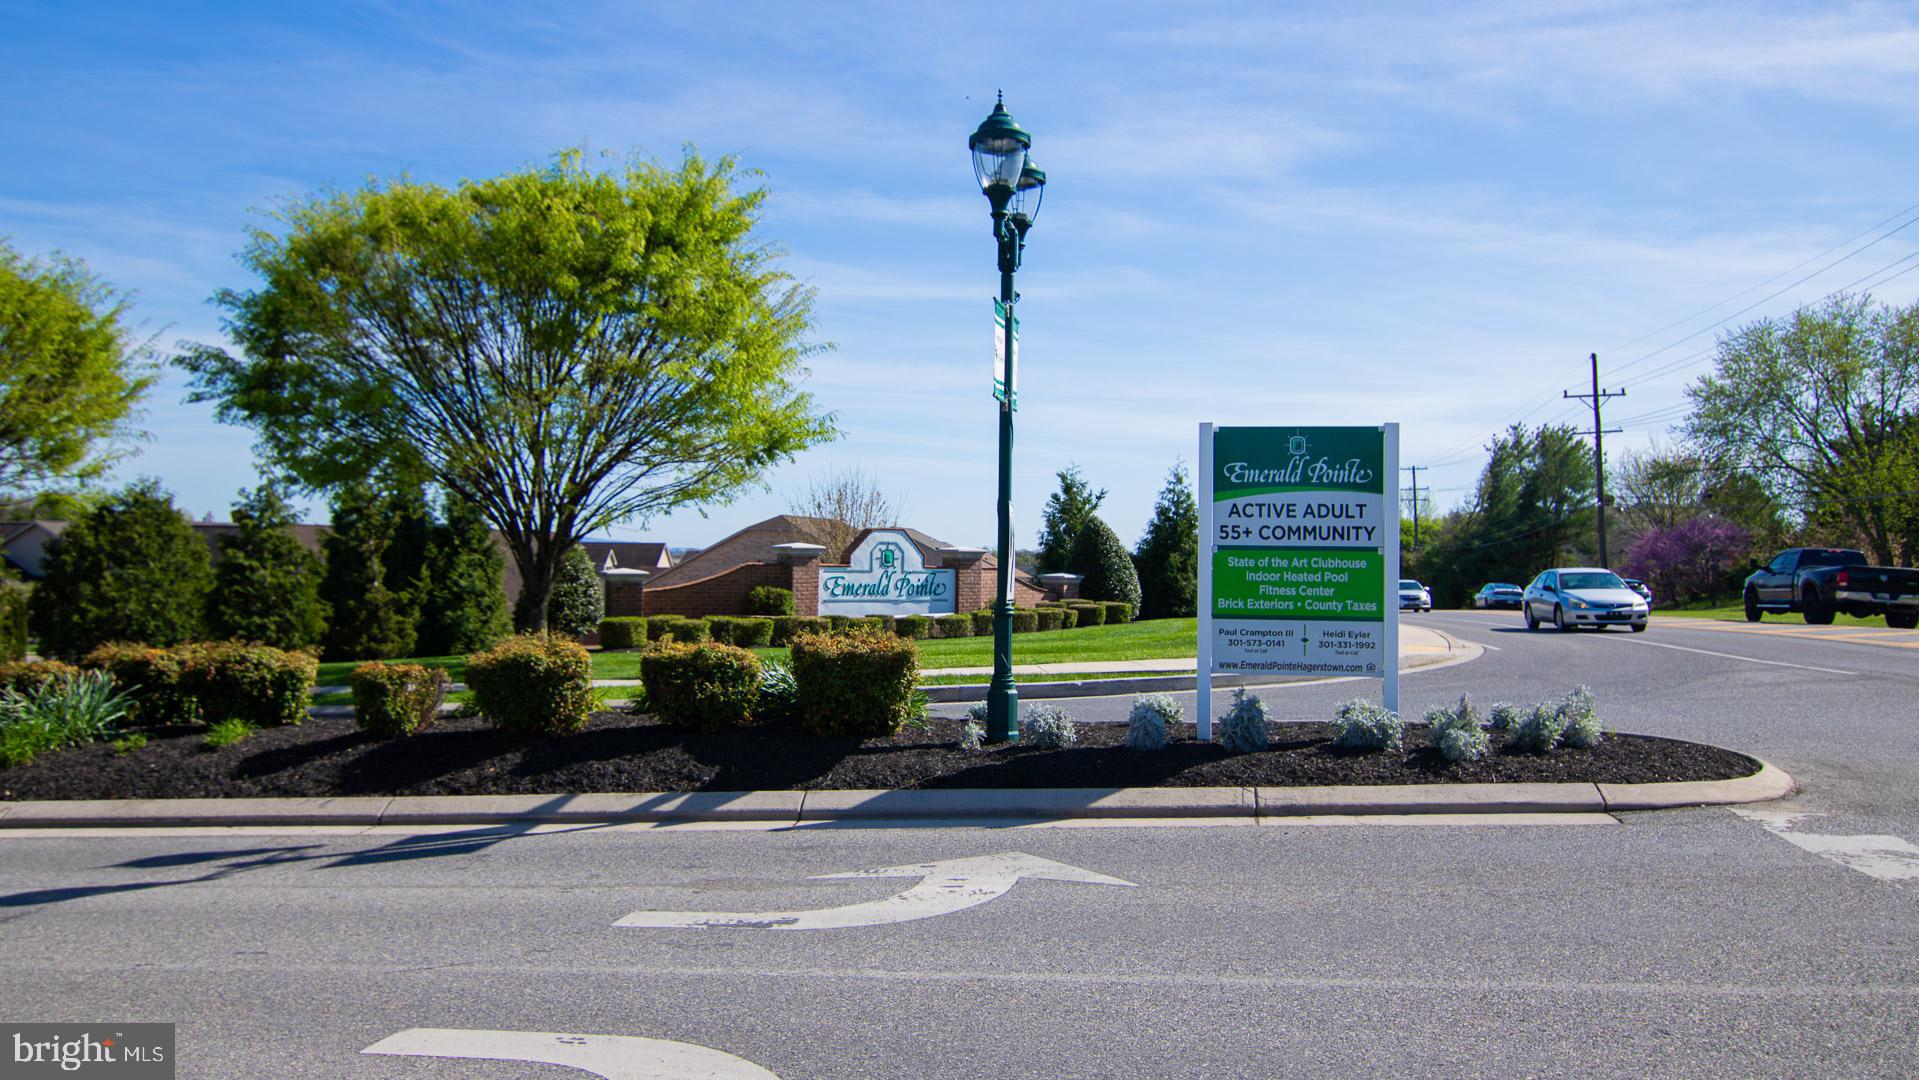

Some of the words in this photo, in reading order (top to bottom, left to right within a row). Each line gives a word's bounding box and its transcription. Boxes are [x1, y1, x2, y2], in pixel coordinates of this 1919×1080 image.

[1223, 455, 1310, 484] Emerald
[1307, 456, 1374, 484] Pointe
[1228, 503, 1297, 518] ACTIVE
[1302, 503, 1367, 519] ADULT
[1219, 525, 1253, 540] 55+
[1258, 525, 1376, 541] COMMUNITY
[1227, 556, 1255, 567] State
[1257, 556, 1270, 567] of
[1271, 557, 1288, 568] the
[1291, 557, 1308, 568] Art
[1311, 557, 1367, 568] Clubhouse
[1246, 571, 1281, 581] Indoor
[1283, 571, 1321, 582] Heated
[1324, 571, 1348, 582] Pool
[824, 569, 897, 598] Emerald
[895, 571, 947, 597] Pointe
[1259, 584, 1296, 595] Fitness
[1299, 585, 1336, 596] Center
[1218, 598, 1245, 609] Brick
[1247, 598, 1294, 610] Exteriors
[1305, 600, 1343, 612] County
[1345, 600, 1377, 611] Taxes
[1218, 628, 1237, 636] Paul
[1239, 628, 1283, 638] Crampton
[1285, 629, 1294, 637] III
[1323, 630, 1346, 638] Heidi
[1348, 630, 1371, 639] Eyler
[1227, 639, 1285, 648] 301-573-0141
[1318, 641, 1376, 649] 301-331-1992
[1218, 660, 1363, 674] www.EmeraldPointeHagerstown.com
